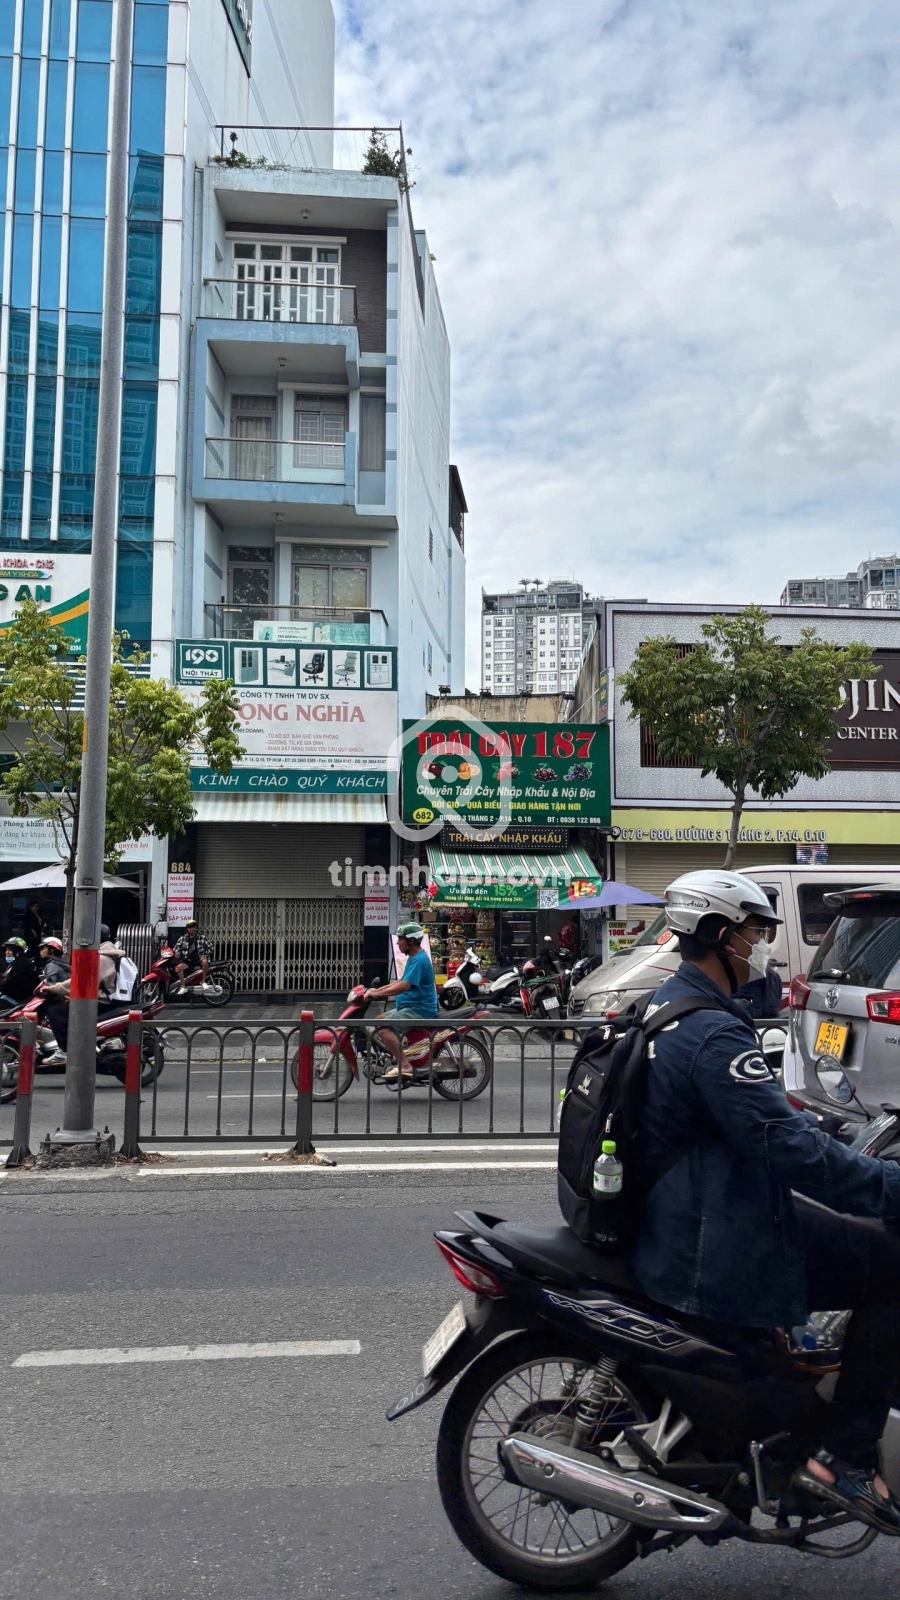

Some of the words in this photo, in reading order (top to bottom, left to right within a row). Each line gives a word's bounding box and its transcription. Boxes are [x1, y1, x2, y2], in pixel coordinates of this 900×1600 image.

[3, 559, 28, 569] KHOA
[36, 560, 54, 569] CN2
[185, 649, 219, 665] 190
[240, 690, 262, 698] CÔNG
[239, 703, 289, 725] ỌNG
[296, 701, 365, 722] NGHĨA
[837, 727, 898, 740] CENTER
[416, 729, 471, 756] TRÁI
[480, 729, 527, 757] CÂY
[532, 731, 597, 758] 187
[198, 773, 239, 785] KÍNH
[248, 774, 289, 786] CHÀO
[297, 775, 328, 788] QUÝ
[336, 775, 385, 787] KHÁCH
[416, 785, 452, 797] Chuyên
[456, 785, 473, 796] Trái
[475, 785, 494, 798] Cây
[497, 786, 522, 799] Nhập
[525, 784, 549, 797] Khẩu
[552, 788, 559, 797] &
[561, 787, 577, 800] Nội
[580, 787, 596, 800] Địa
[467, 799, 482, 809] QUÀ
[484, 799, 501, 809] BIẾU
[509, 802, 526, 810] GIAO
[528, 801, 549, 810] HÀNG
[552, 802, 566, 812] TẬN
[568, 802, 581, 810] NƠI
[415, 811, 431, 820] 682
[468, 813, 489, 822] THÁNG
[449, 832, 473, 842] TRÁI
[475, 832, 496, 842] CÂY
[499, 833, 529, 845] NHẬP
[532, 832, 562, 843] KHẨU
[676, 825, 714, 841] ĐƯỜNG
[716, 829, 723, 841] 3
[727, 826, 762, 841] TÁNG
[804, 829, 826, 842] Q.10
[171, 862, 191, 873] 684
[493, 884, 518, 897] 15%
